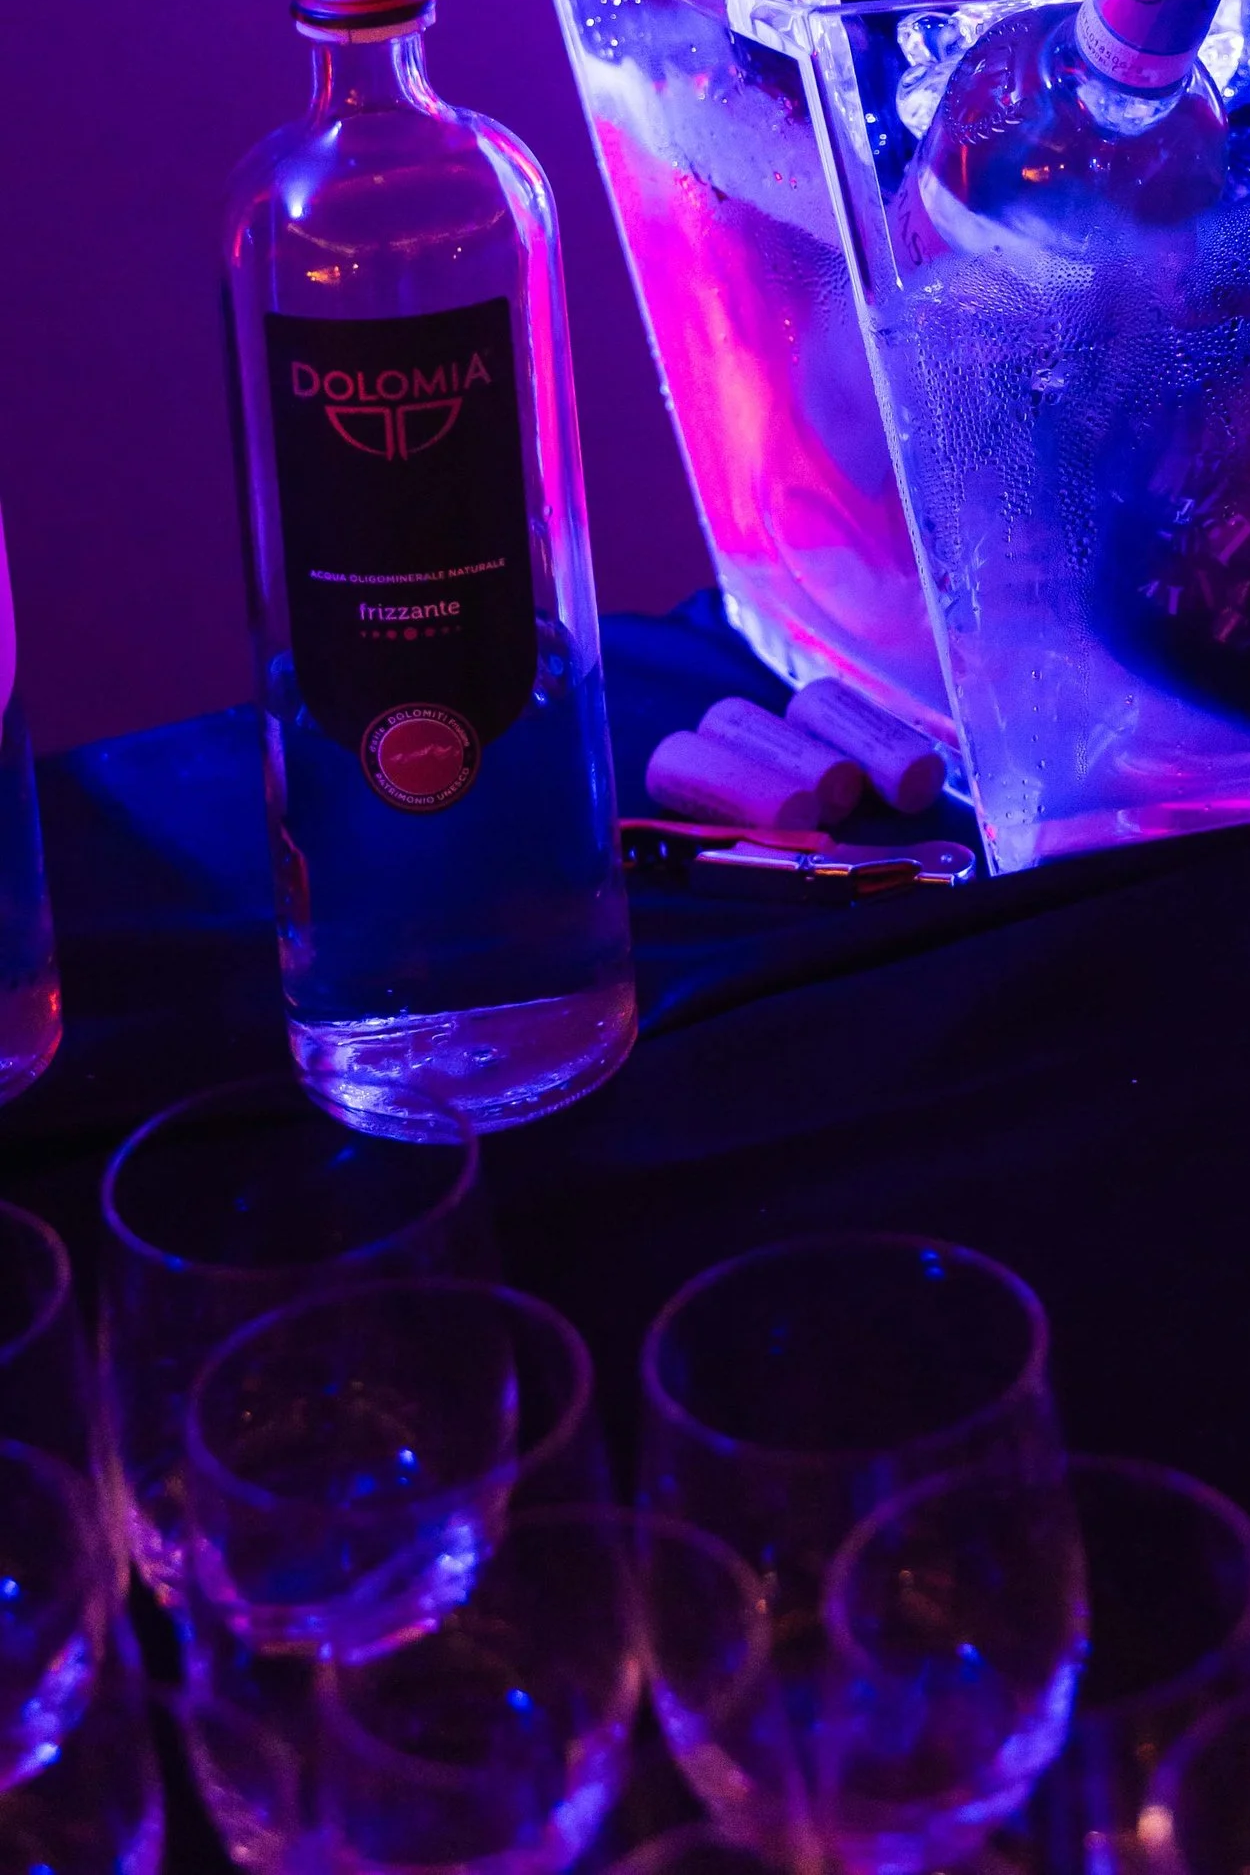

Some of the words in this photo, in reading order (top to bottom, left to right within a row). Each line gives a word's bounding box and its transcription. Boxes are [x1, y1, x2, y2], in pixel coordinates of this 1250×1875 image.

[291, 351, 492, 402] DOLOMIA
[310, 569, 347, 582] ACQUA
[349, 571, 446, 584] OLIGOMINERALE
[448, 557, 506, 579] NATURALE
[359, 600, 461, 621] frizzante
[387, 708, 448, 725] DOLOMITI
[375, 772, 435, 805] PATRIMONIO
[436, 767, 470, 801] UNESCO
